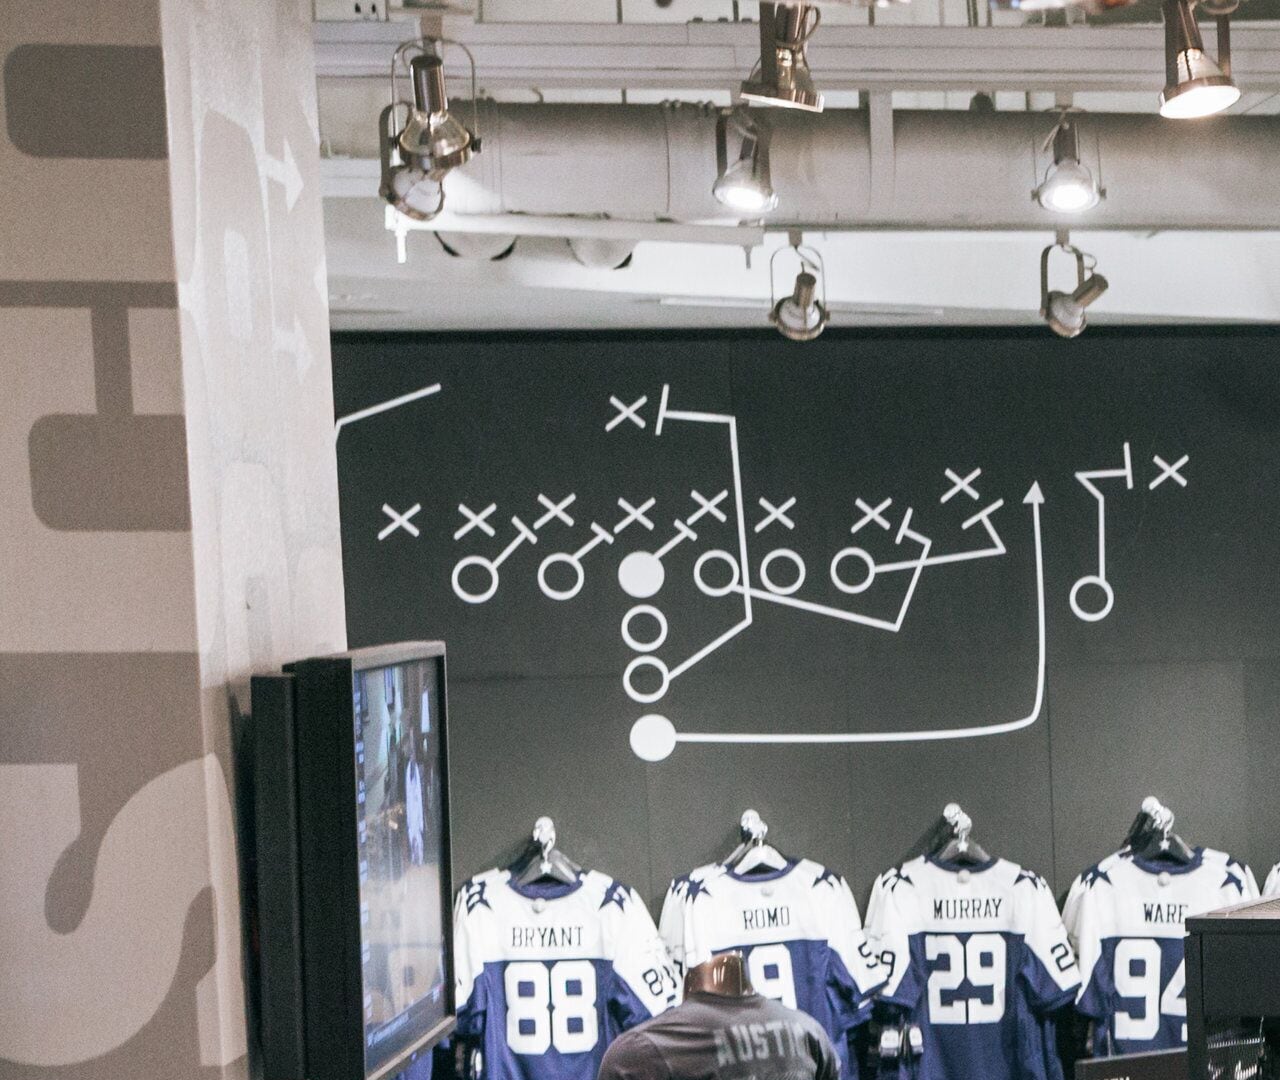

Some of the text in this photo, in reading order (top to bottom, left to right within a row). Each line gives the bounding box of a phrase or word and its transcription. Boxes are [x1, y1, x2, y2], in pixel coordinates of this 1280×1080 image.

[742, 905, 792, 931] ROMO
[932, 897, 1004, 921] MURRAY
[1143, 902, 1189, 925] WARE
[511, 925, 584, 948] BRYANT
[925, 933, 1007, 1025] 29
[504, 959, 599, 1056] 88
